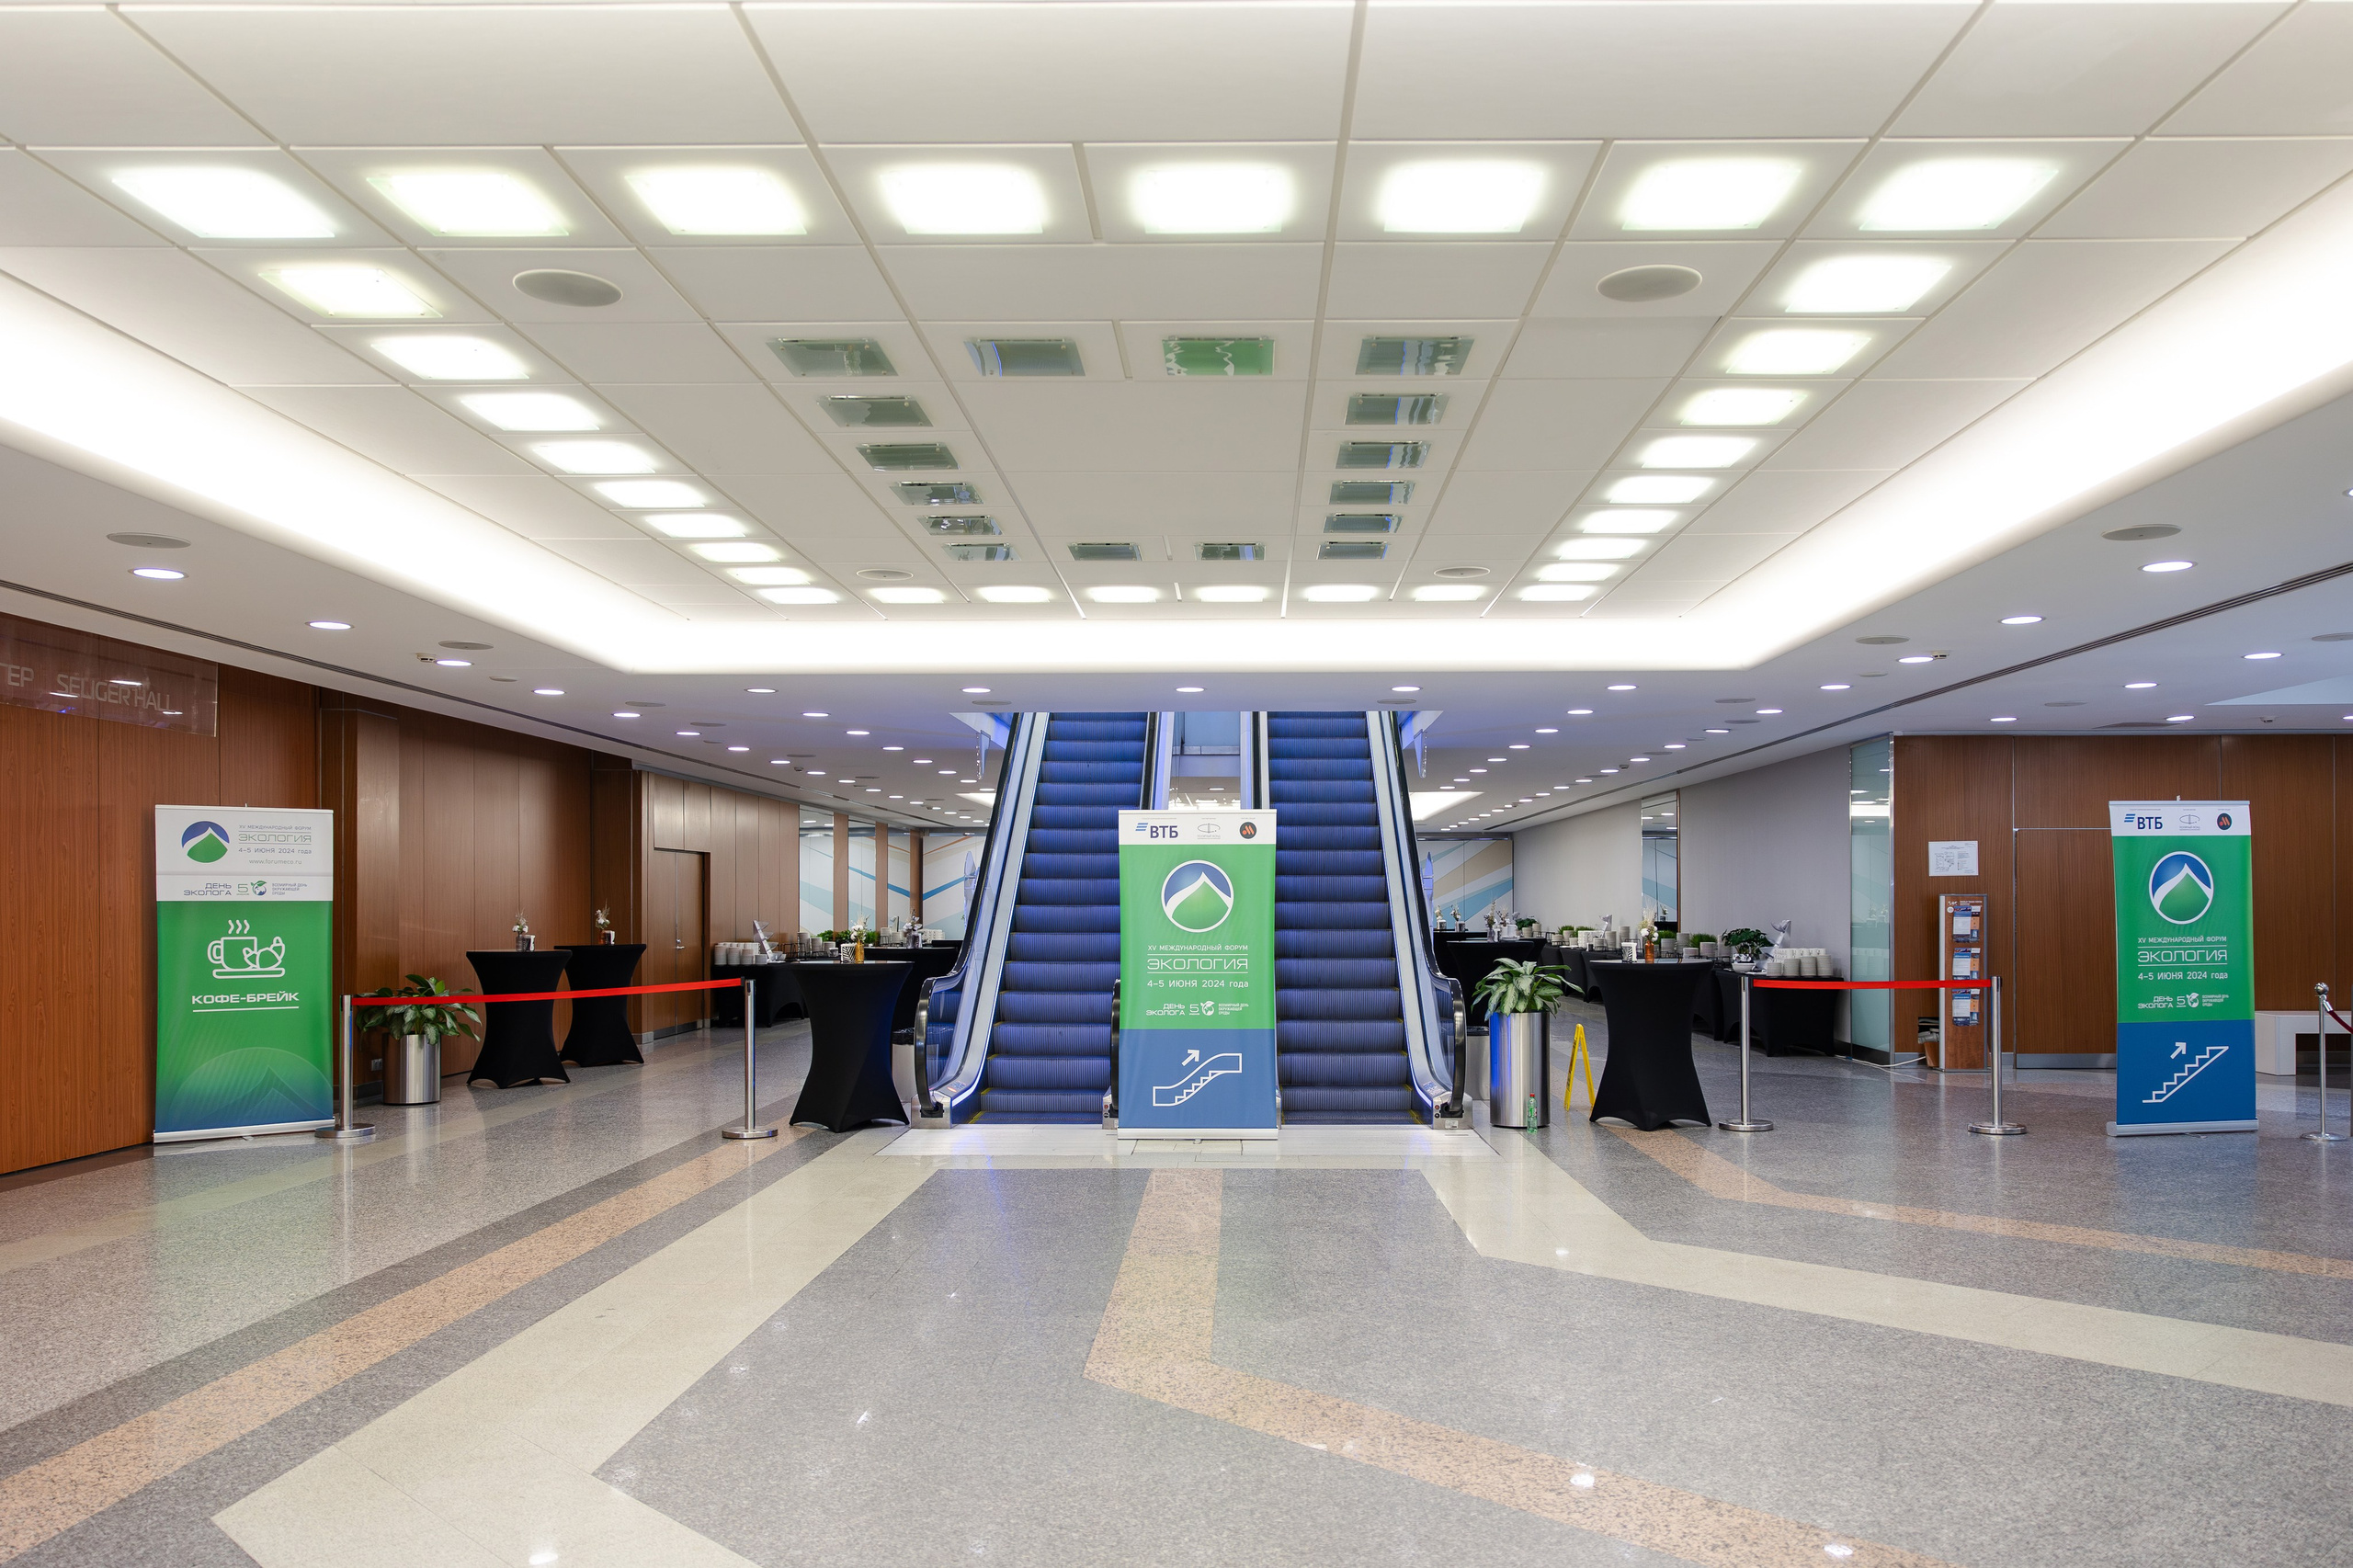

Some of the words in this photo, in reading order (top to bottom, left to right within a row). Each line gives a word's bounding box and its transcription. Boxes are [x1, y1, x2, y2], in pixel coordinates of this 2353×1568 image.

[57, 674, 130, 706] SELIGER
[134, 688, 172, 711] HALL
[2137, 816, 2163, 830] ВТБ
[238, 834, 312, 843] ЭКОЛОГИЯ
[1150, 825, 1178, 839] ВТБ
[2137, 949, 2227, 962] ЭКОЛОГИЯ
[1147, 959, 1248, 970] ЭКОЛОГИЯ
[2157, 971, 2183, 980] ИЮНЯ
[192, 991, 300, 1005] КОФЕ-БРЕЙК
